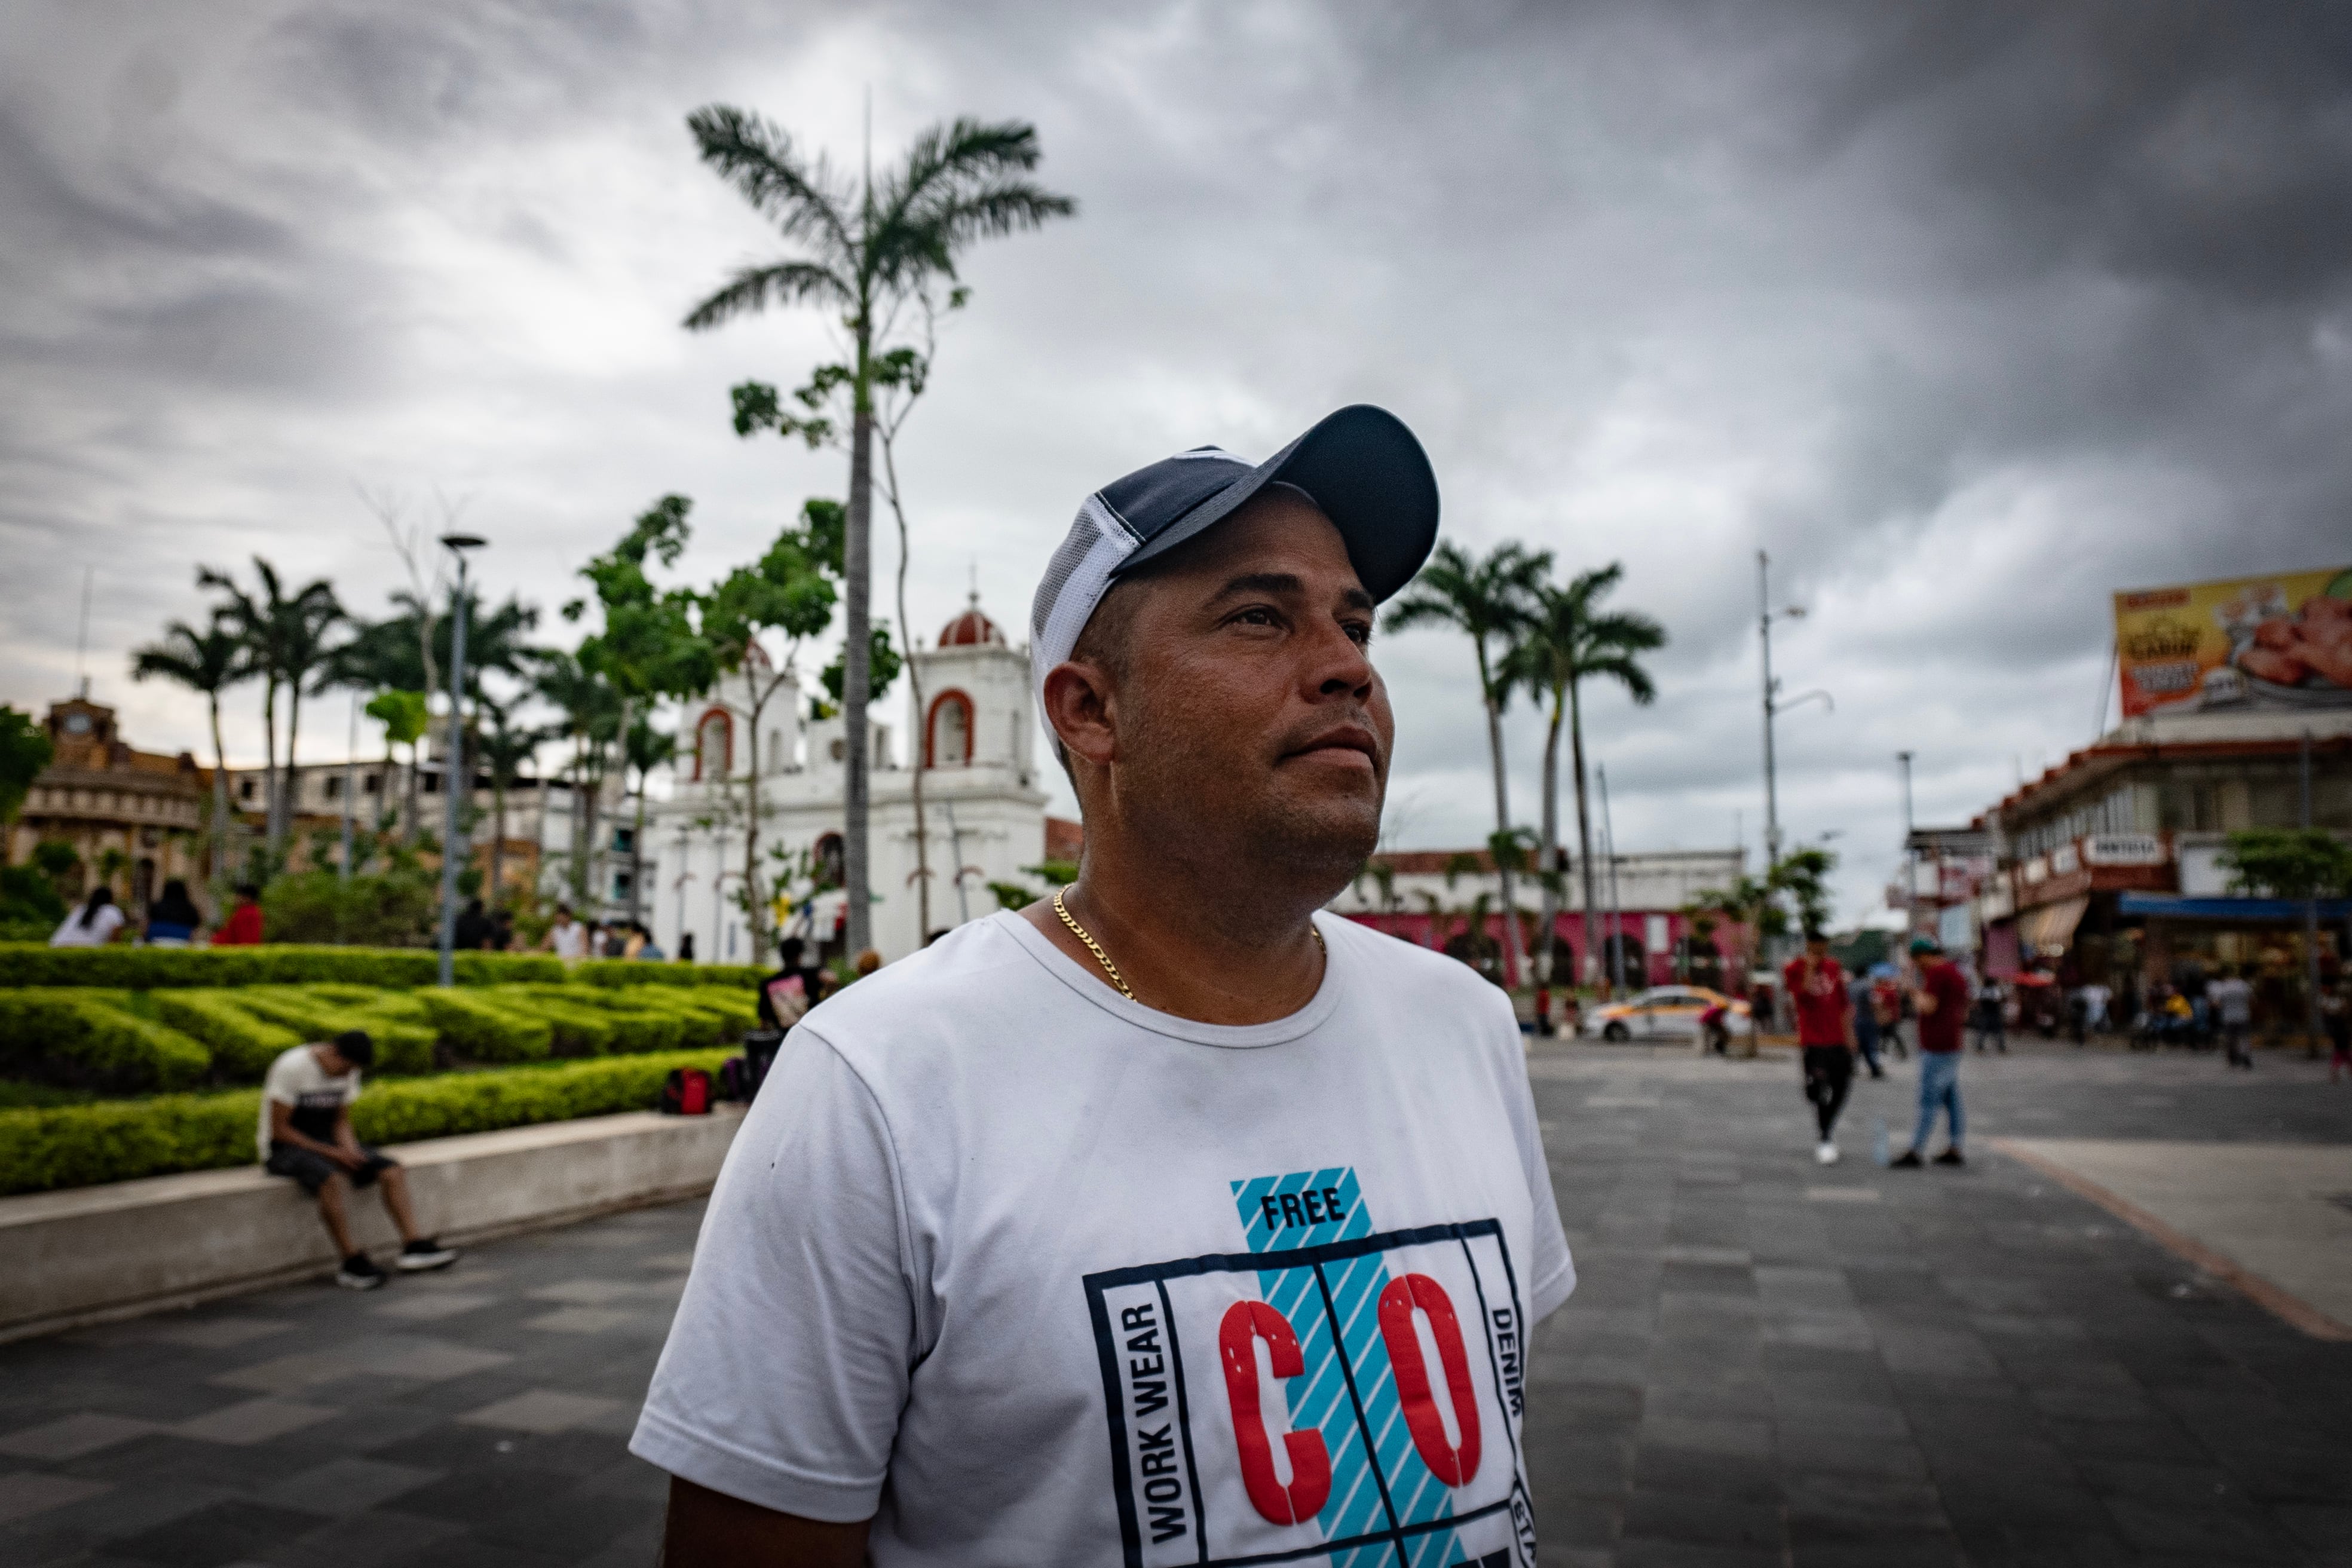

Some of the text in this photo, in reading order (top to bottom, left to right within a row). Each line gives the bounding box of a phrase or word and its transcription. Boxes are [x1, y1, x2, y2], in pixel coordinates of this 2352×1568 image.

[1260, 1187, 1346, 1231] FREE
[1492, 1307, 1522, 1418] DENIM
[1121, 1303, 1187, 1545] WORK WEAR
